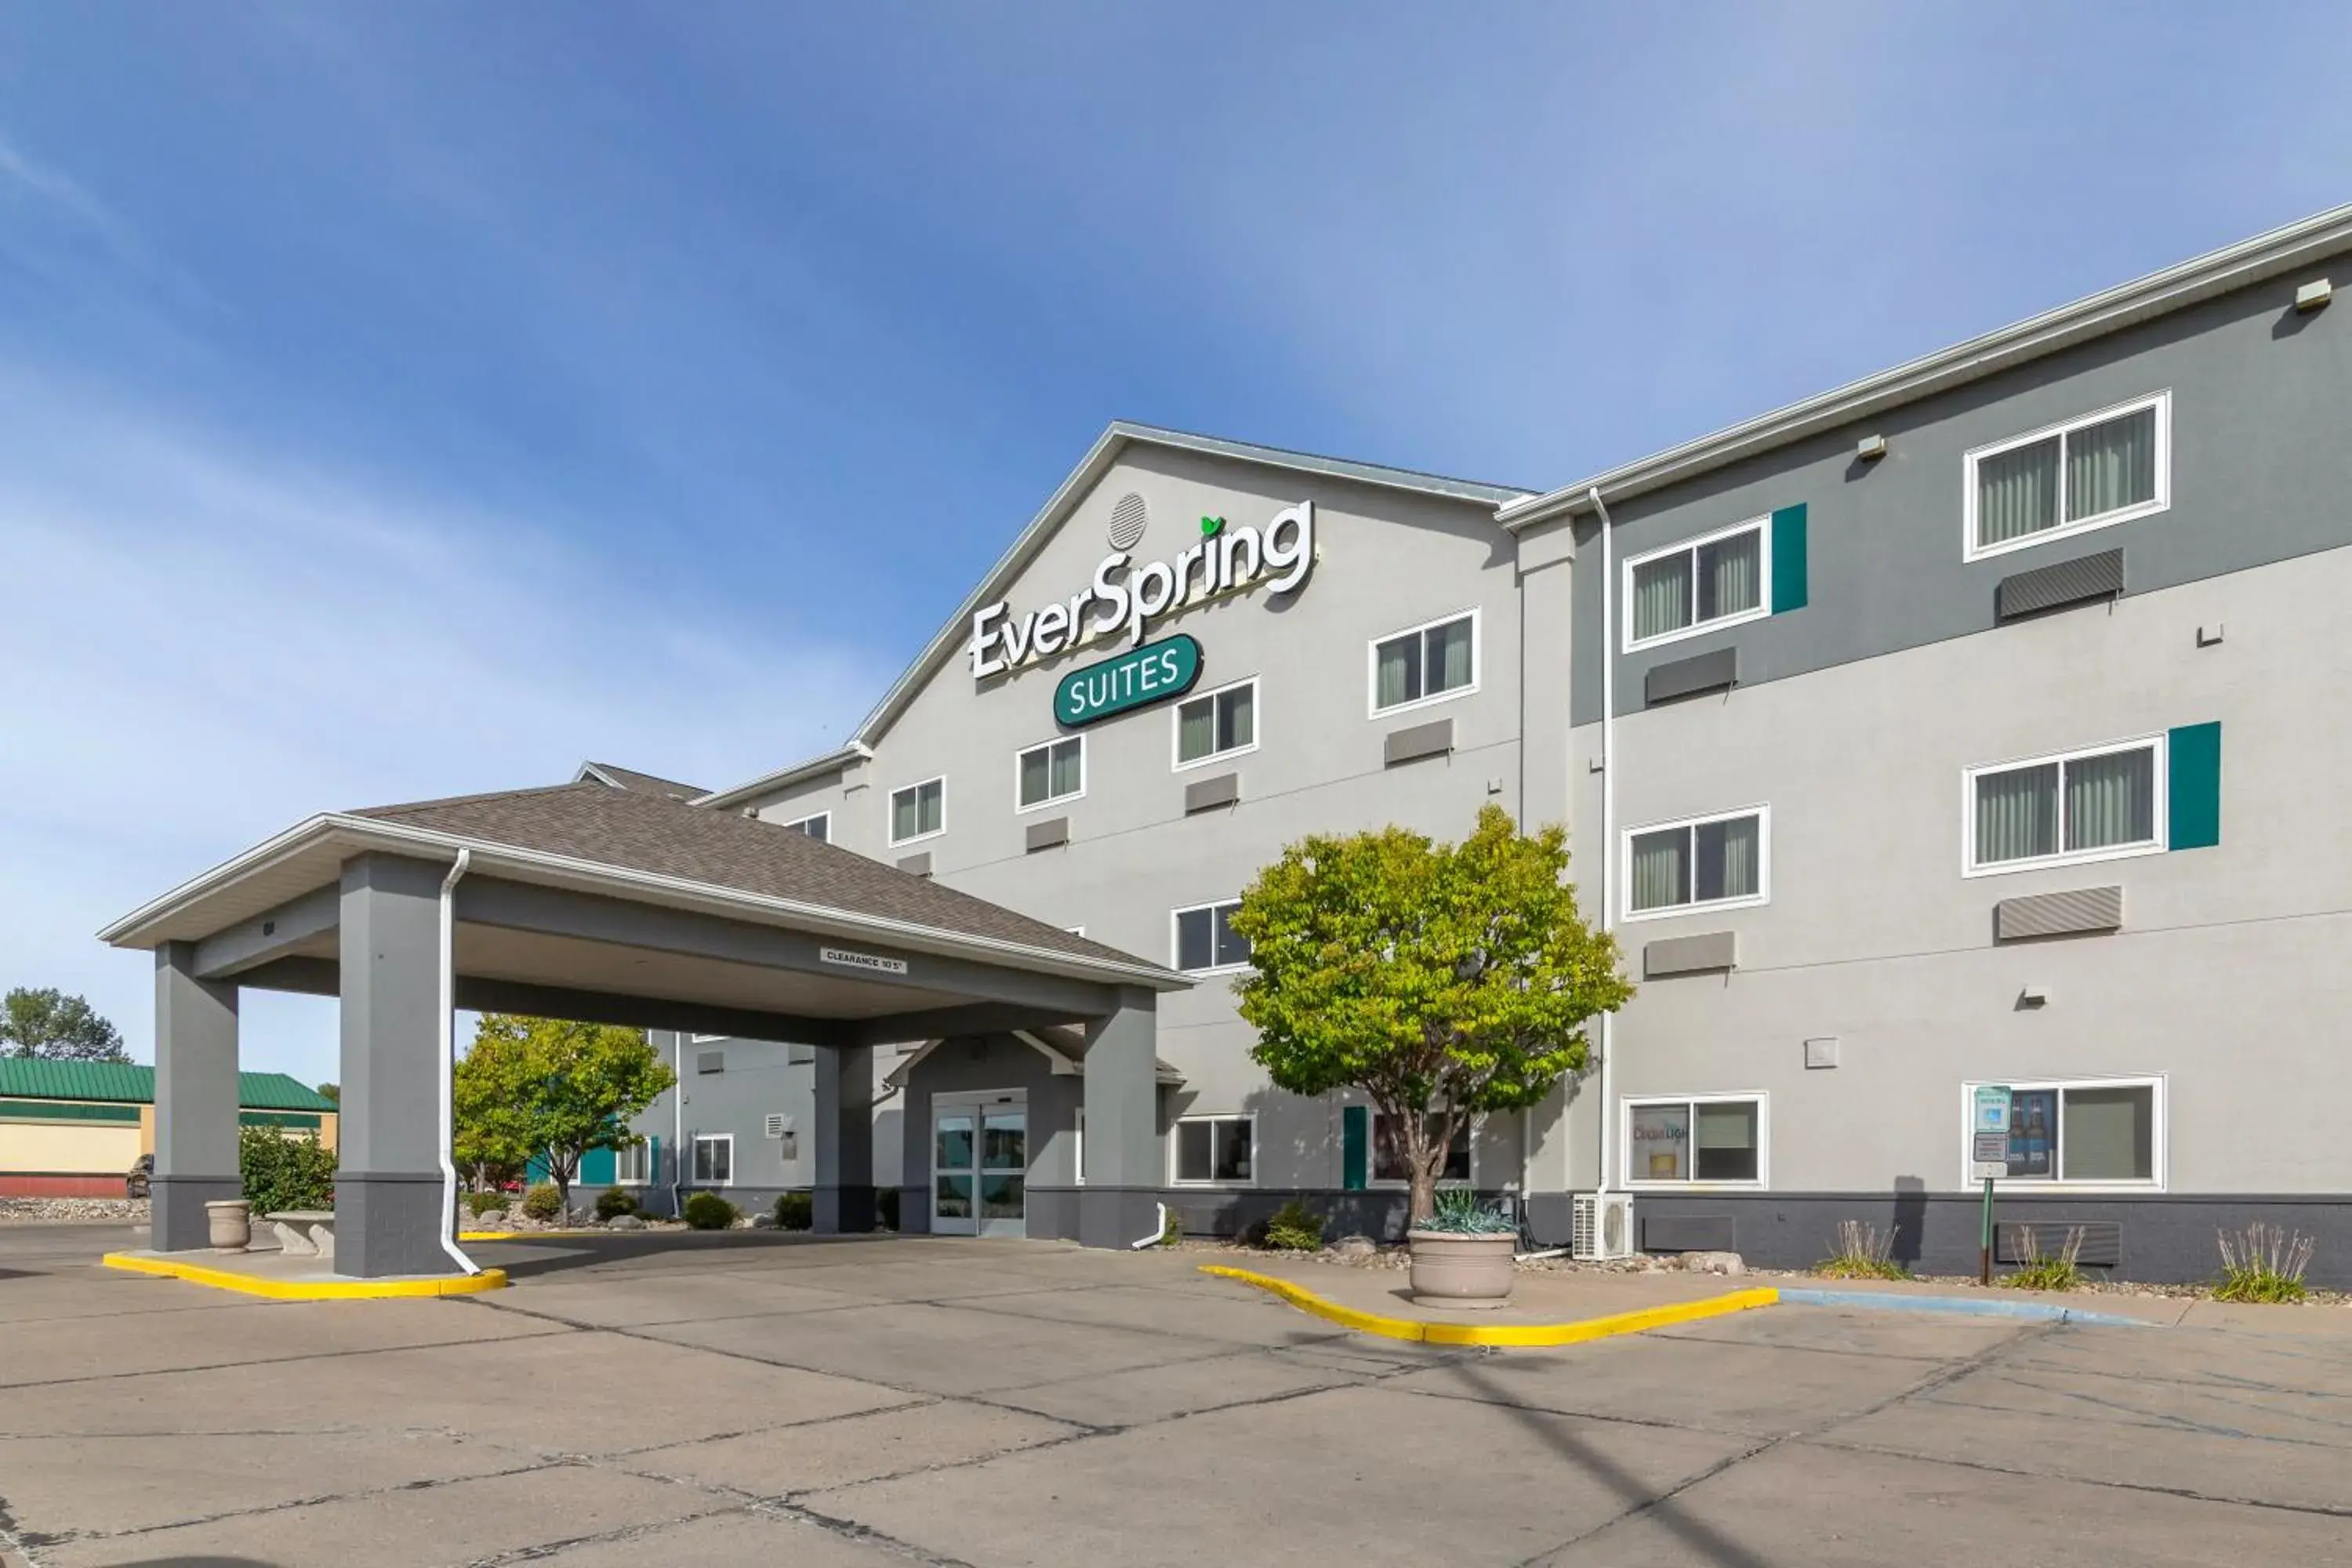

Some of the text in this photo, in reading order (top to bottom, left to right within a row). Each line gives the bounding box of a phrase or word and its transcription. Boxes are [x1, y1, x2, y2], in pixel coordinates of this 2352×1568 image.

[973, 499, 1314, 678] EverSpring
[1070, 648, 1178, 714] SUITES
[827, 951, 879, 967] CLEARANCE
